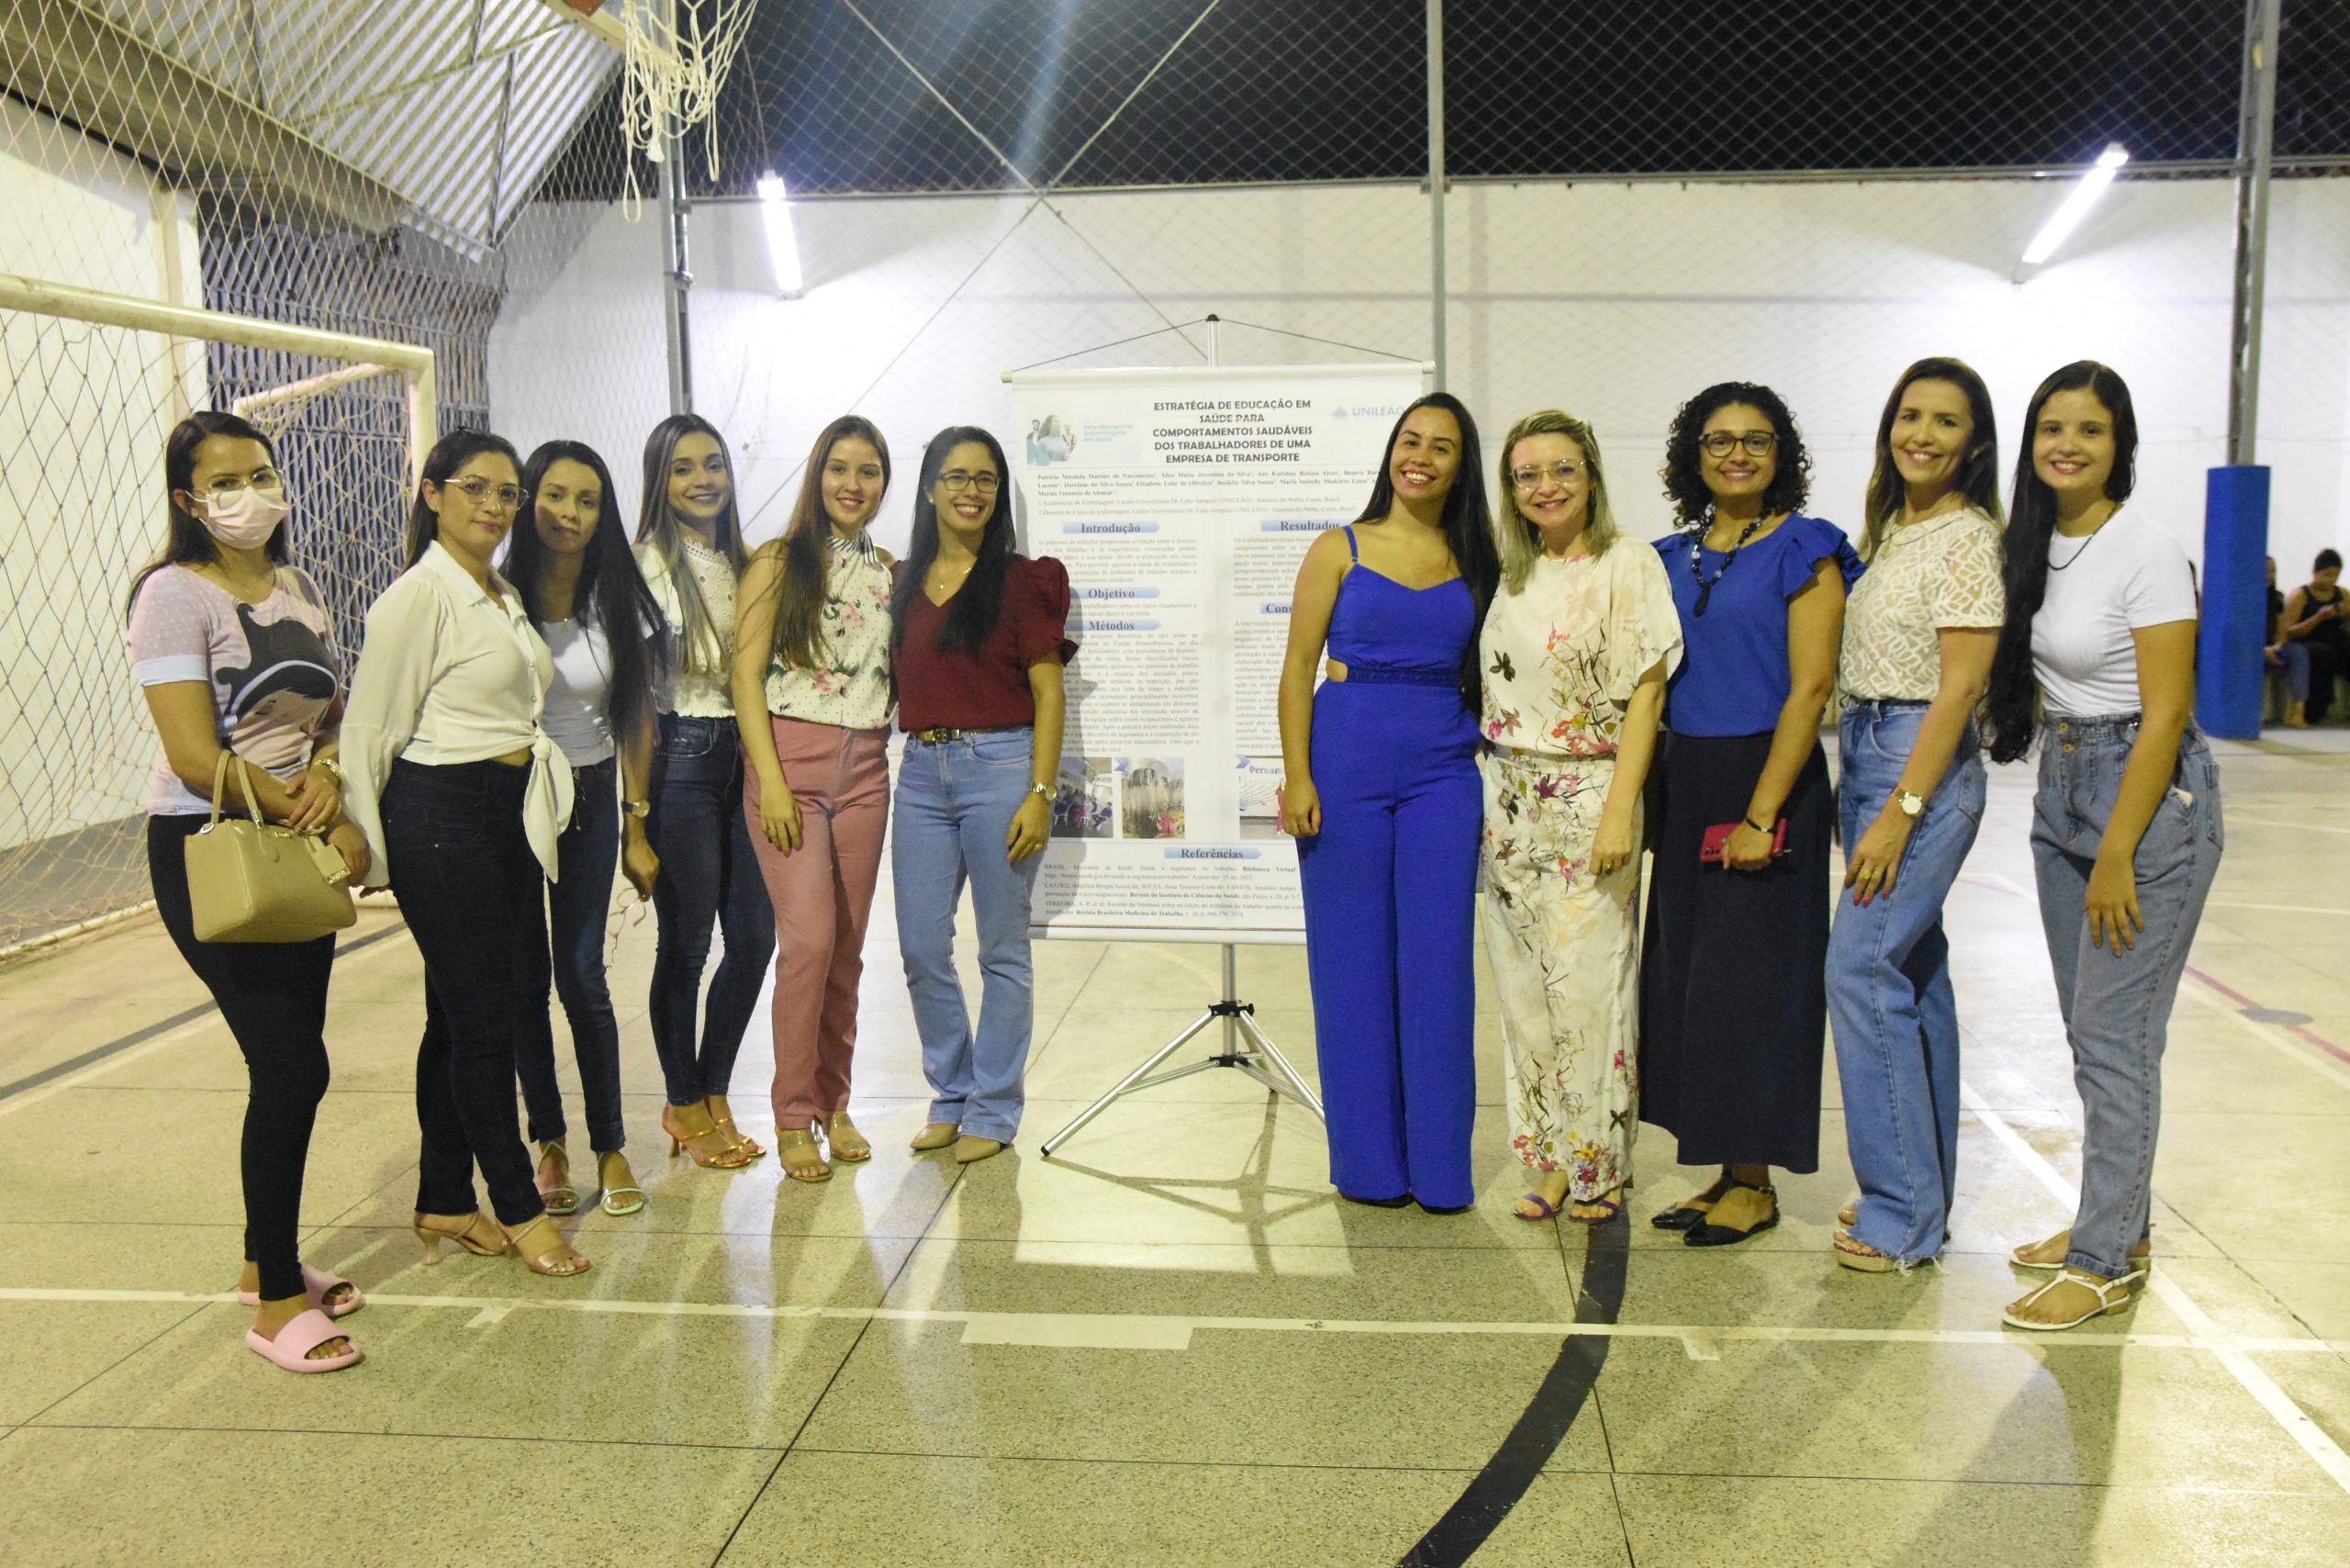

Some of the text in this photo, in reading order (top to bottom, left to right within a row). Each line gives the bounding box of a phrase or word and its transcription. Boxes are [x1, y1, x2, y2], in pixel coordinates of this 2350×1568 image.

[1154, 398, 1311, 411] ESTRATÉGIA DE EDUCAÇÃO EM
[1199, 412, 1265, 423] SAÚDE PARA
[1153, 425, 1313, 437] COMPORTAMENTOS SAUDÁVEIS
[1154, 440, 1311, 450] DOS TRABALHADORES DE UMA
[1166, 453, 1300, 463] EMPRESA DE TRANSPORTE
[1081, 523, 1141, 534] Introdução
[1280, 521, 1340, 531] Resultados
[1088, 588, 1135, 600] Objetivo
[1089, 619, 1135, 631] Métodos
[1181, 849, 1243, 859] Referências
